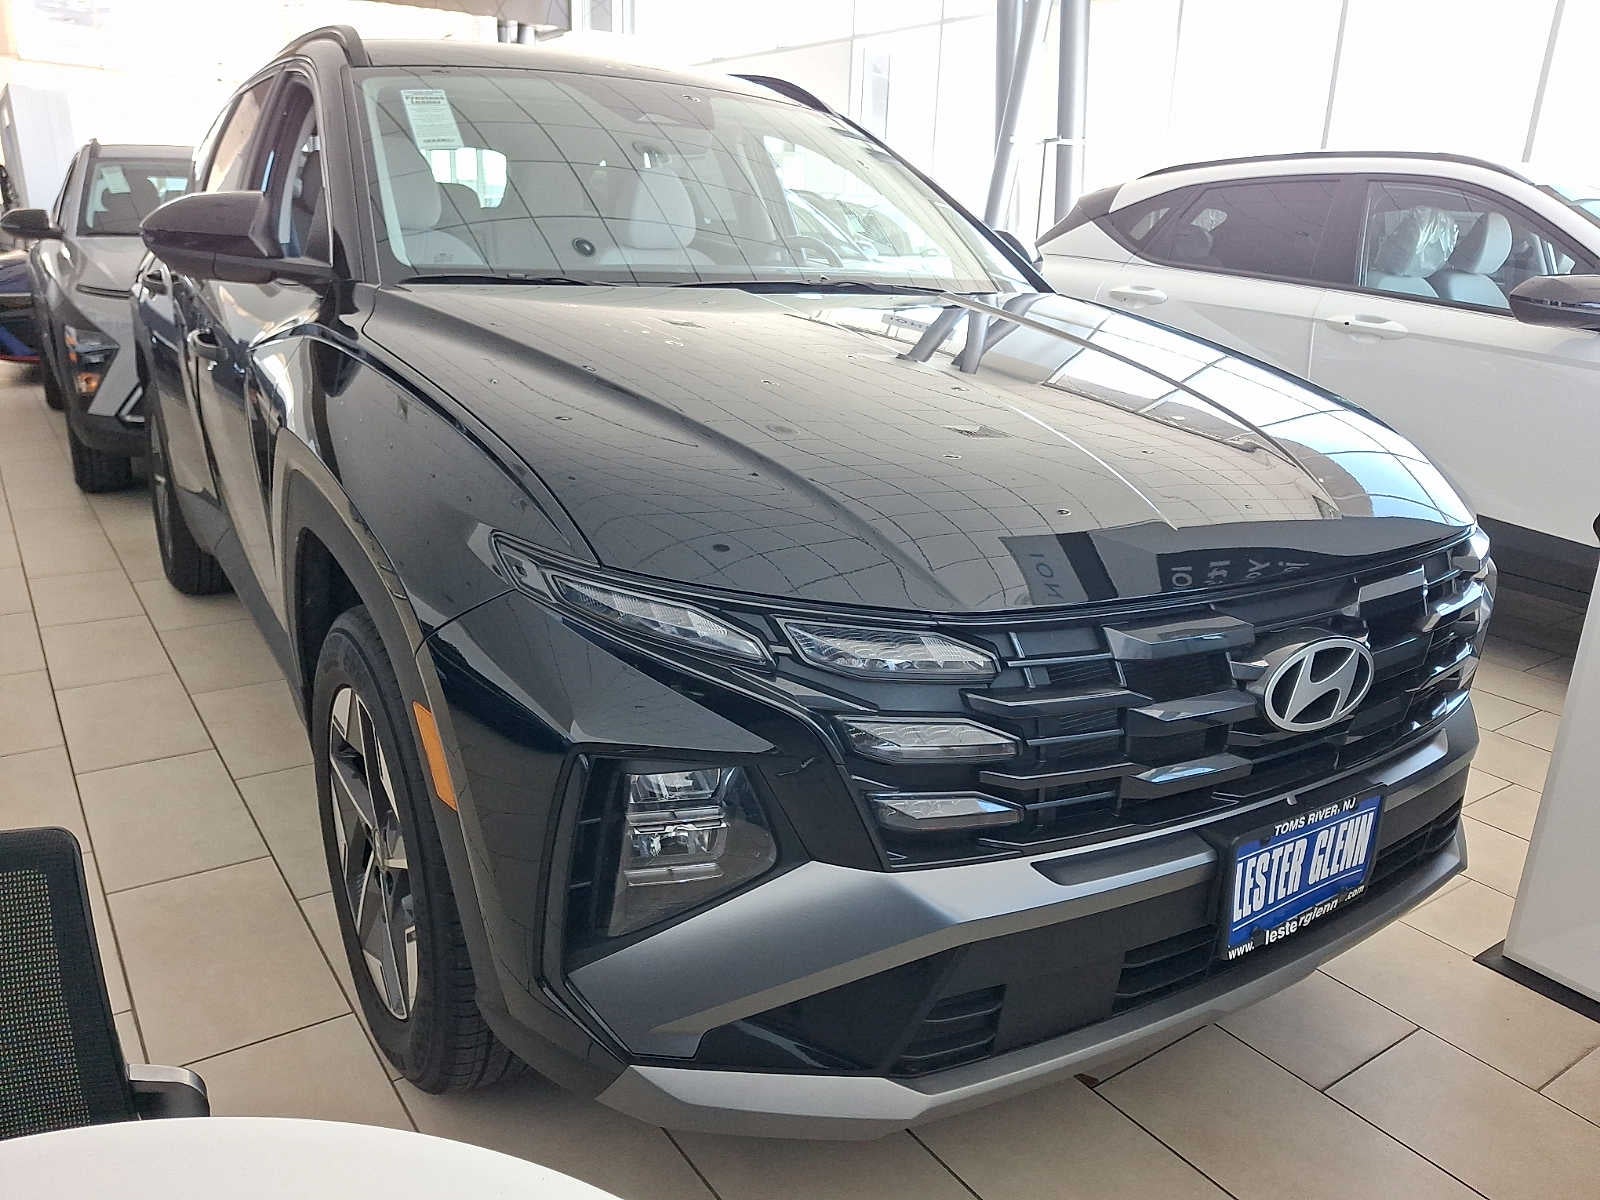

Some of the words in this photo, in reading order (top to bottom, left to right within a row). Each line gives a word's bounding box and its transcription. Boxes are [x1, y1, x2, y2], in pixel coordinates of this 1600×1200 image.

[1275, 819, 1305, 836] TOMS
[1308, 805, 1340, 824] RIVER,
[1343, 798, 1356, 811] NJ
[1233, 838, 1307, 922] LESTER
[1309, 811, 1375, 885] GLENN
